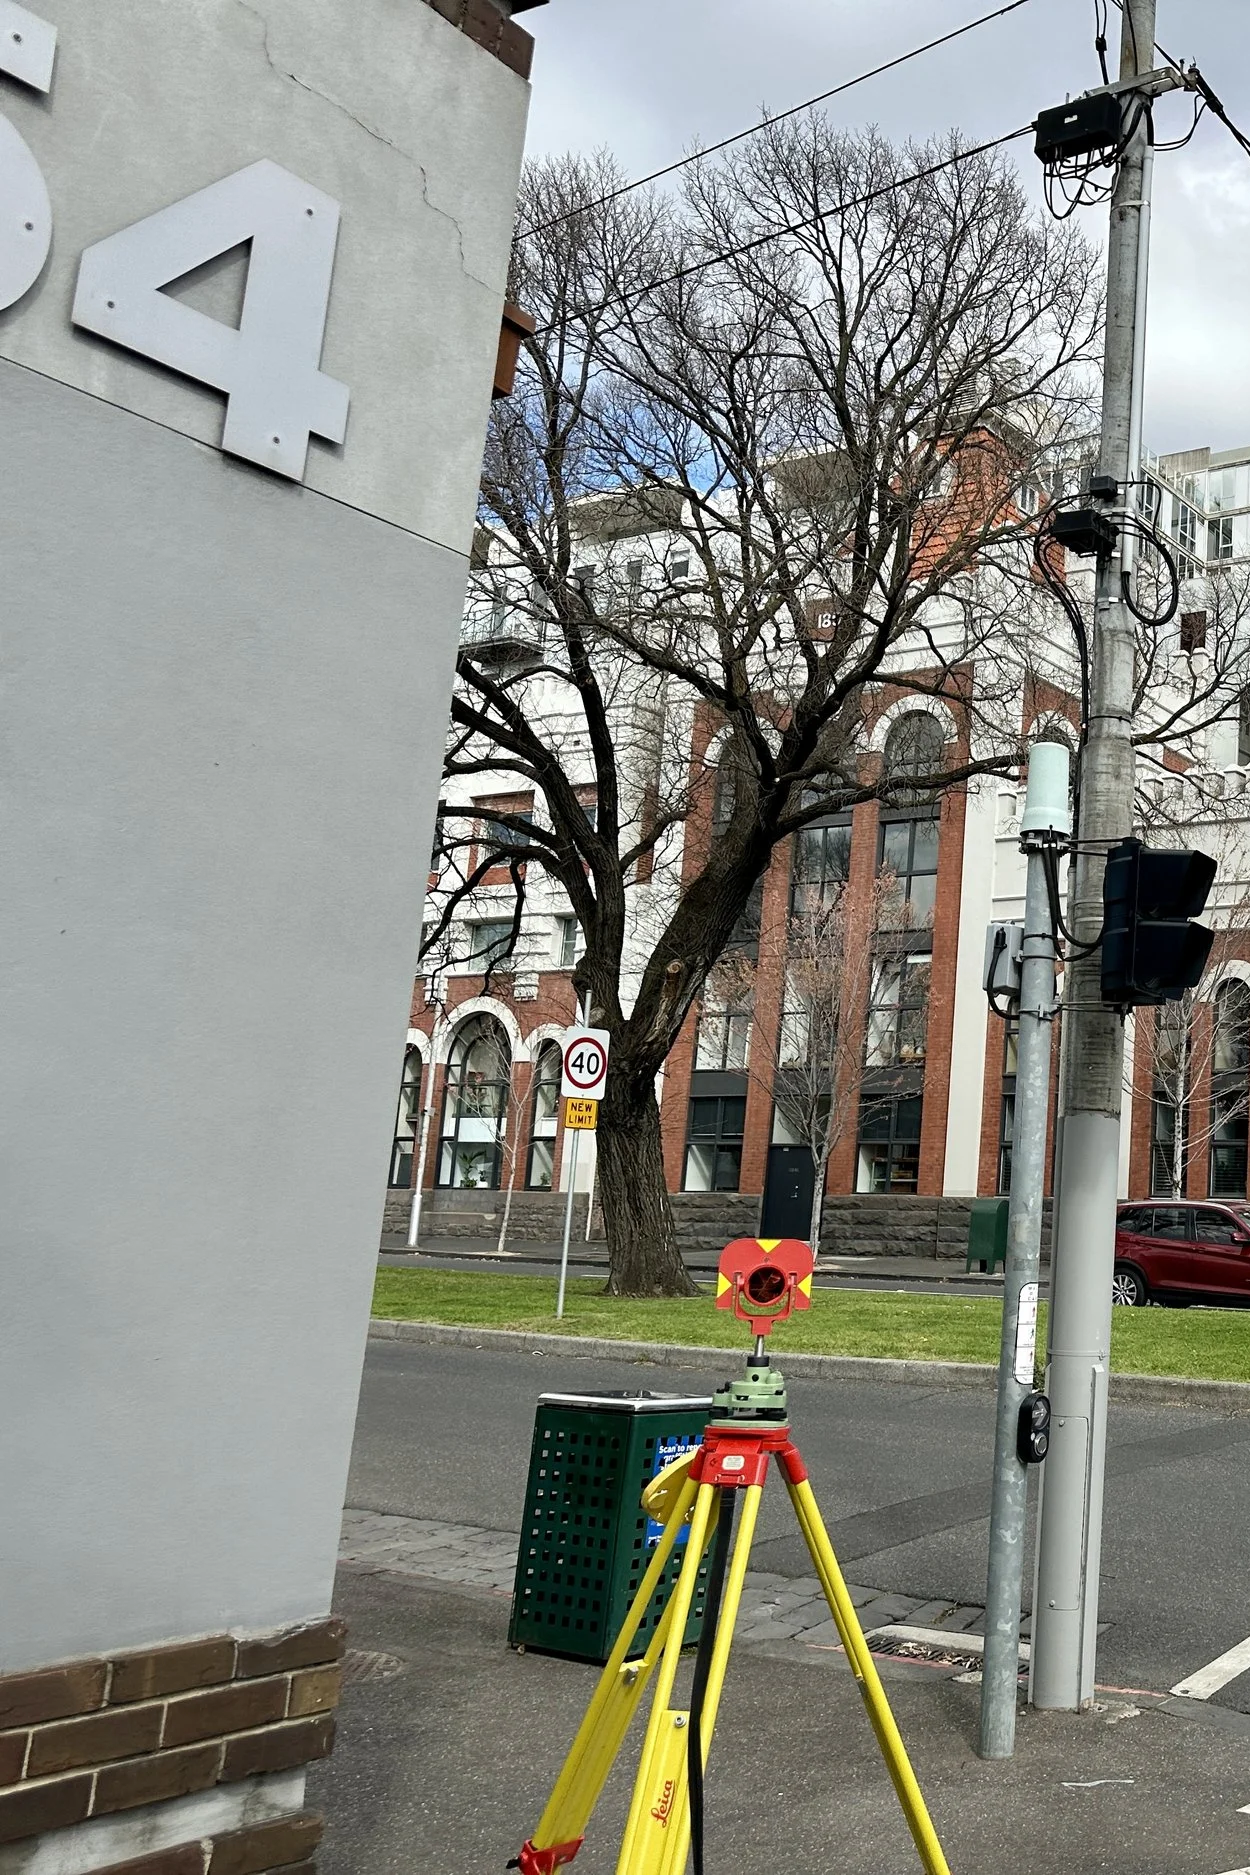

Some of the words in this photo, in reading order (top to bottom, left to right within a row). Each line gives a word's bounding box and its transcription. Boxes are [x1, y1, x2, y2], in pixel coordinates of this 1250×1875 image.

[0, 0, 350, 483] 4
[571, 1051, 600, 1075] 40
[570, 1102, 592, 1112] NEW
[569, 1115, 592, 1125] LIMIT
[659, 1445, 676, 1454] Scan
[650, 1779, 676, 1828] Leica
